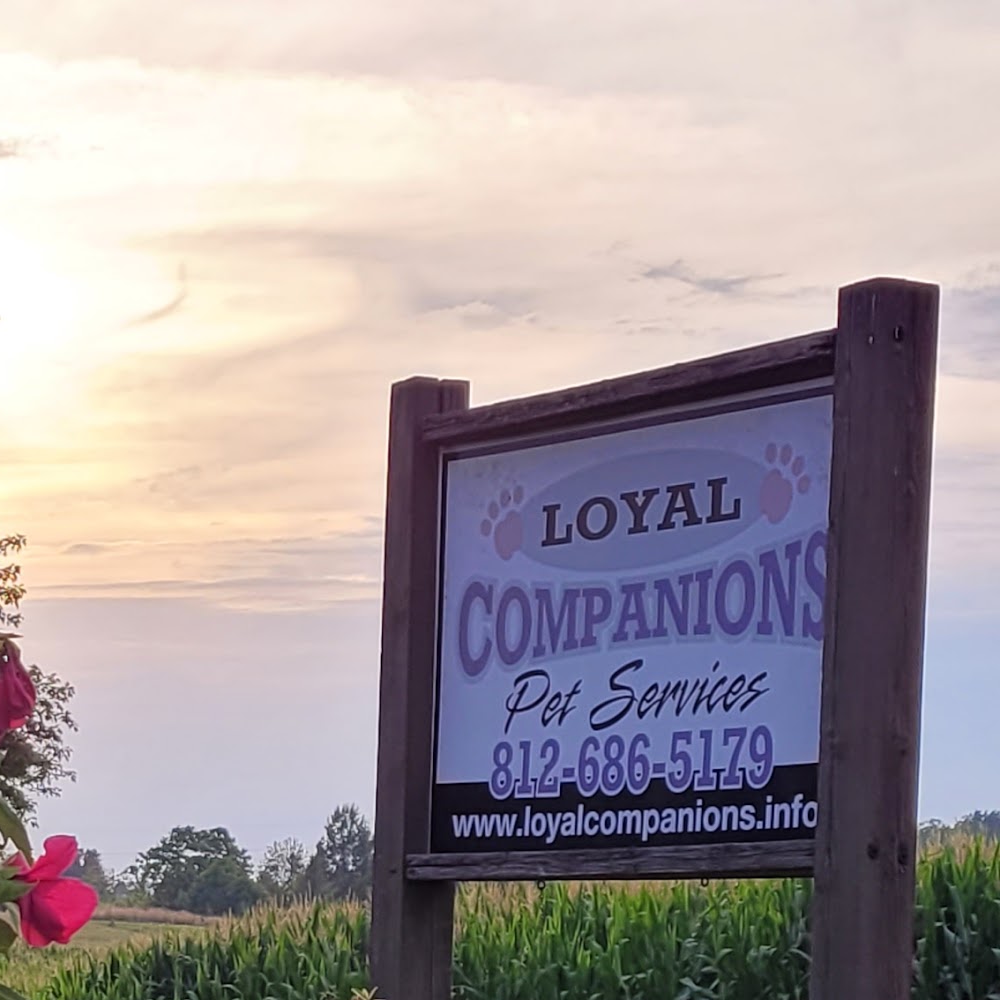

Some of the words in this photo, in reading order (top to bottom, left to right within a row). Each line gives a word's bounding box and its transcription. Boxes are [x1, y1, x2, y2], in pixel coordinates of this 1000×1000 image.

[541, 477, 741, 547] LOYAL
[458, 529, 829, 677] COMPANIONS
[504, 668, 583, 734] Pet
[589, 658, 770, 731] Services
[490, 725, 773, 799] 812-686-5179
[452, 793, 818, 844] www.loyalcompanions.info
